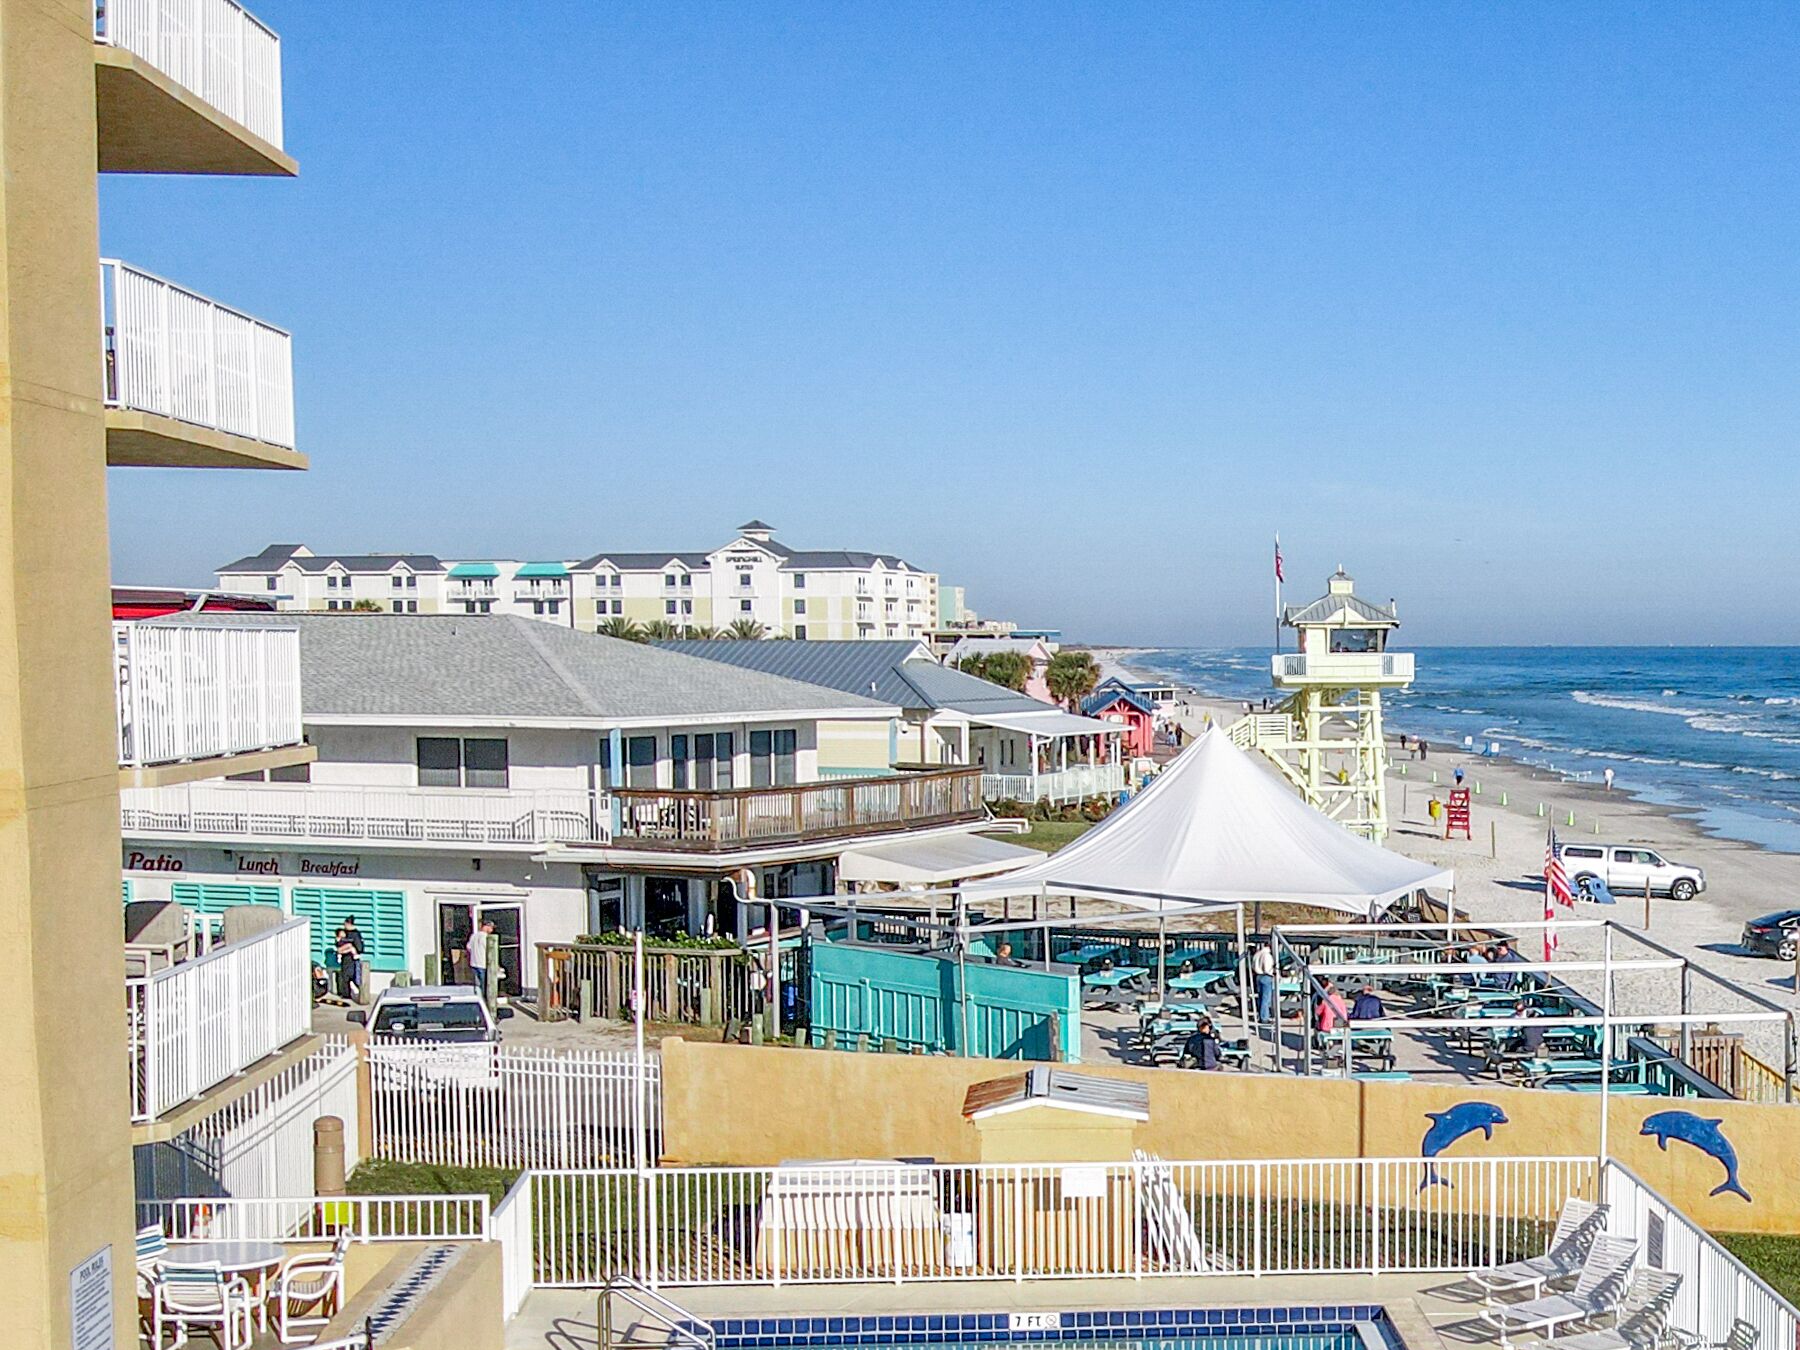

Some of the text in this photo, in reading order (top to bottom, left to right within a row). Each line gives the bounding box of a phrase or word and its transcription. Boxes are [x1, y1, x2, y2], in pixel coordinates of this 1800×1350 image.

[128, 852, 183, 872] Patio
[238, 856, 280, 875] Lunch
[301, 857, 360, 877] Breakfast
[1015, 1316, 1021, 1327] 7
